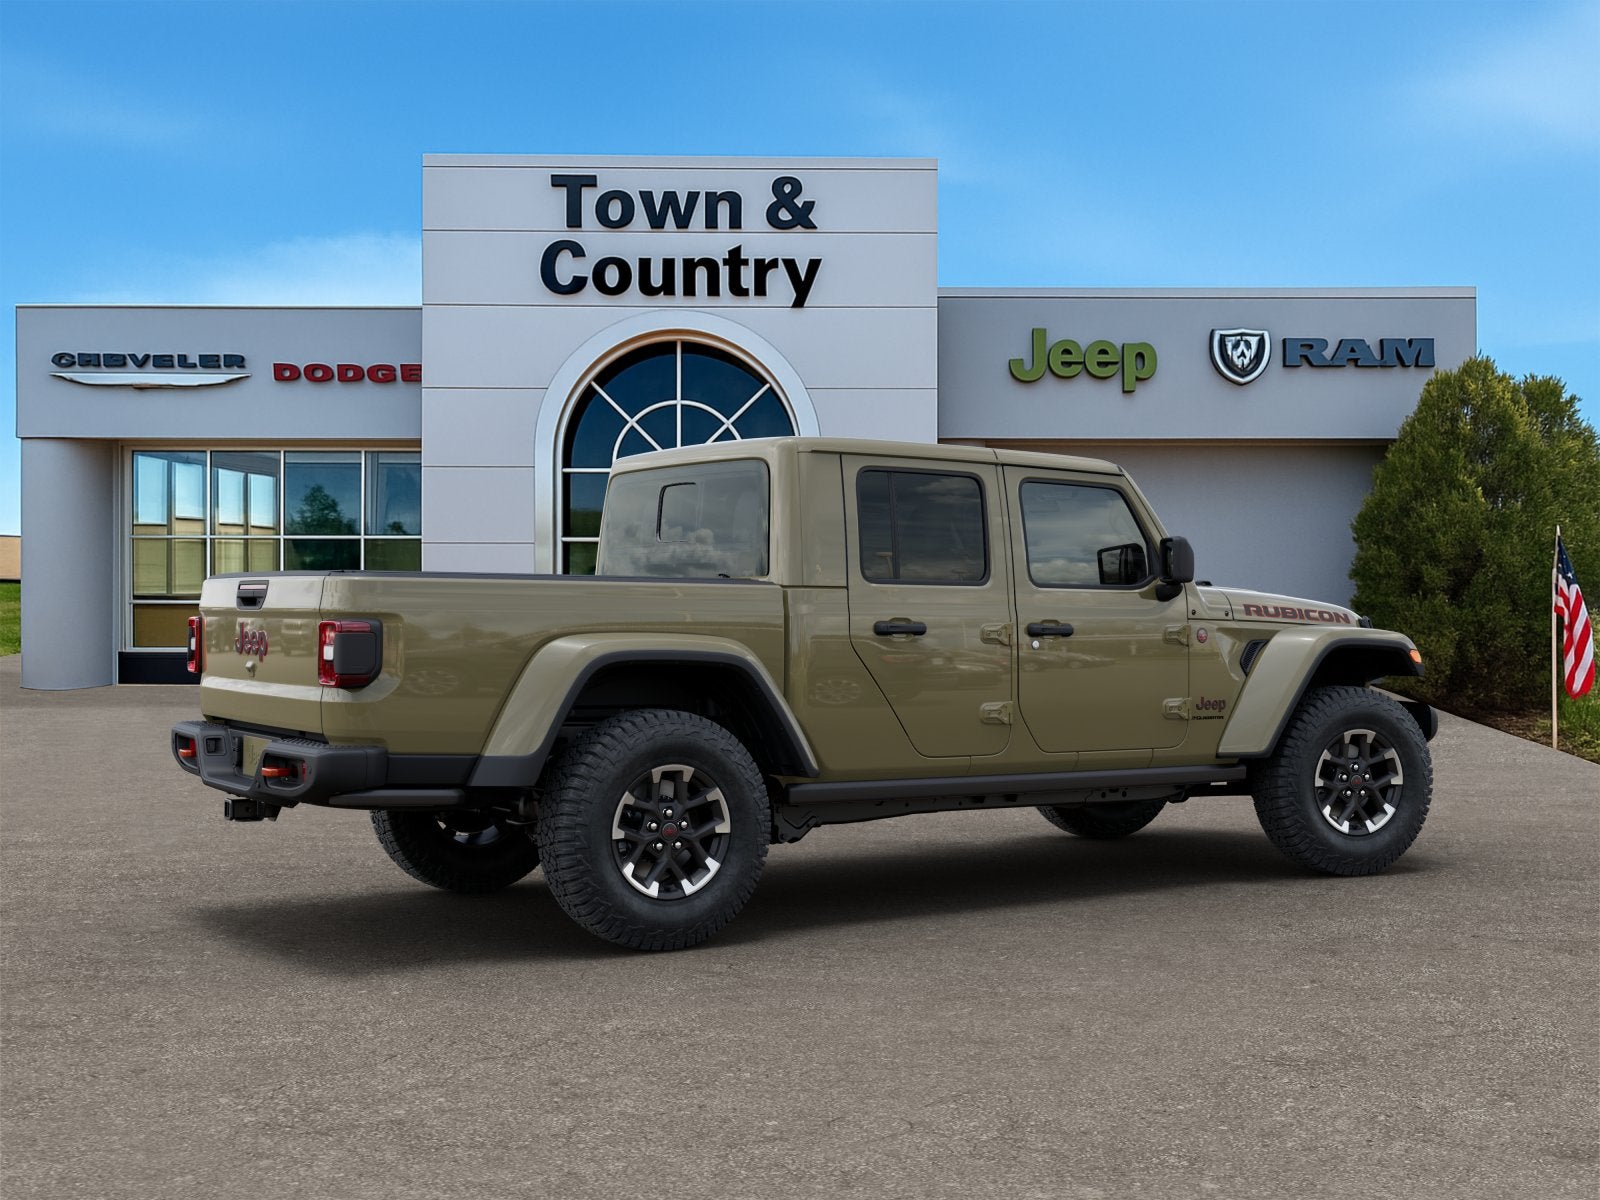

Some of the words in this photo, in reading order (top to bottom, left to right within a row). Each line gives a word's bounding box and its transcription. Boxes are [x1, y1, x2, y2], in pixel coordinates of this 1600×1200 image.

[551, 174, 742, 229] Town
[765, 176, 818, 229] &
[540, 239, 822, 308] Country
[1009, 327, 1157, 393] Jeep
[1282, 338, 1435, 367] RAM
[273, 362, 422, 383] DODGE
[1243, 603, 1351, 624] RUBICON
[235, 621, 269, 663] Jeep
[1195, 696, 1226, 712] Jeep
